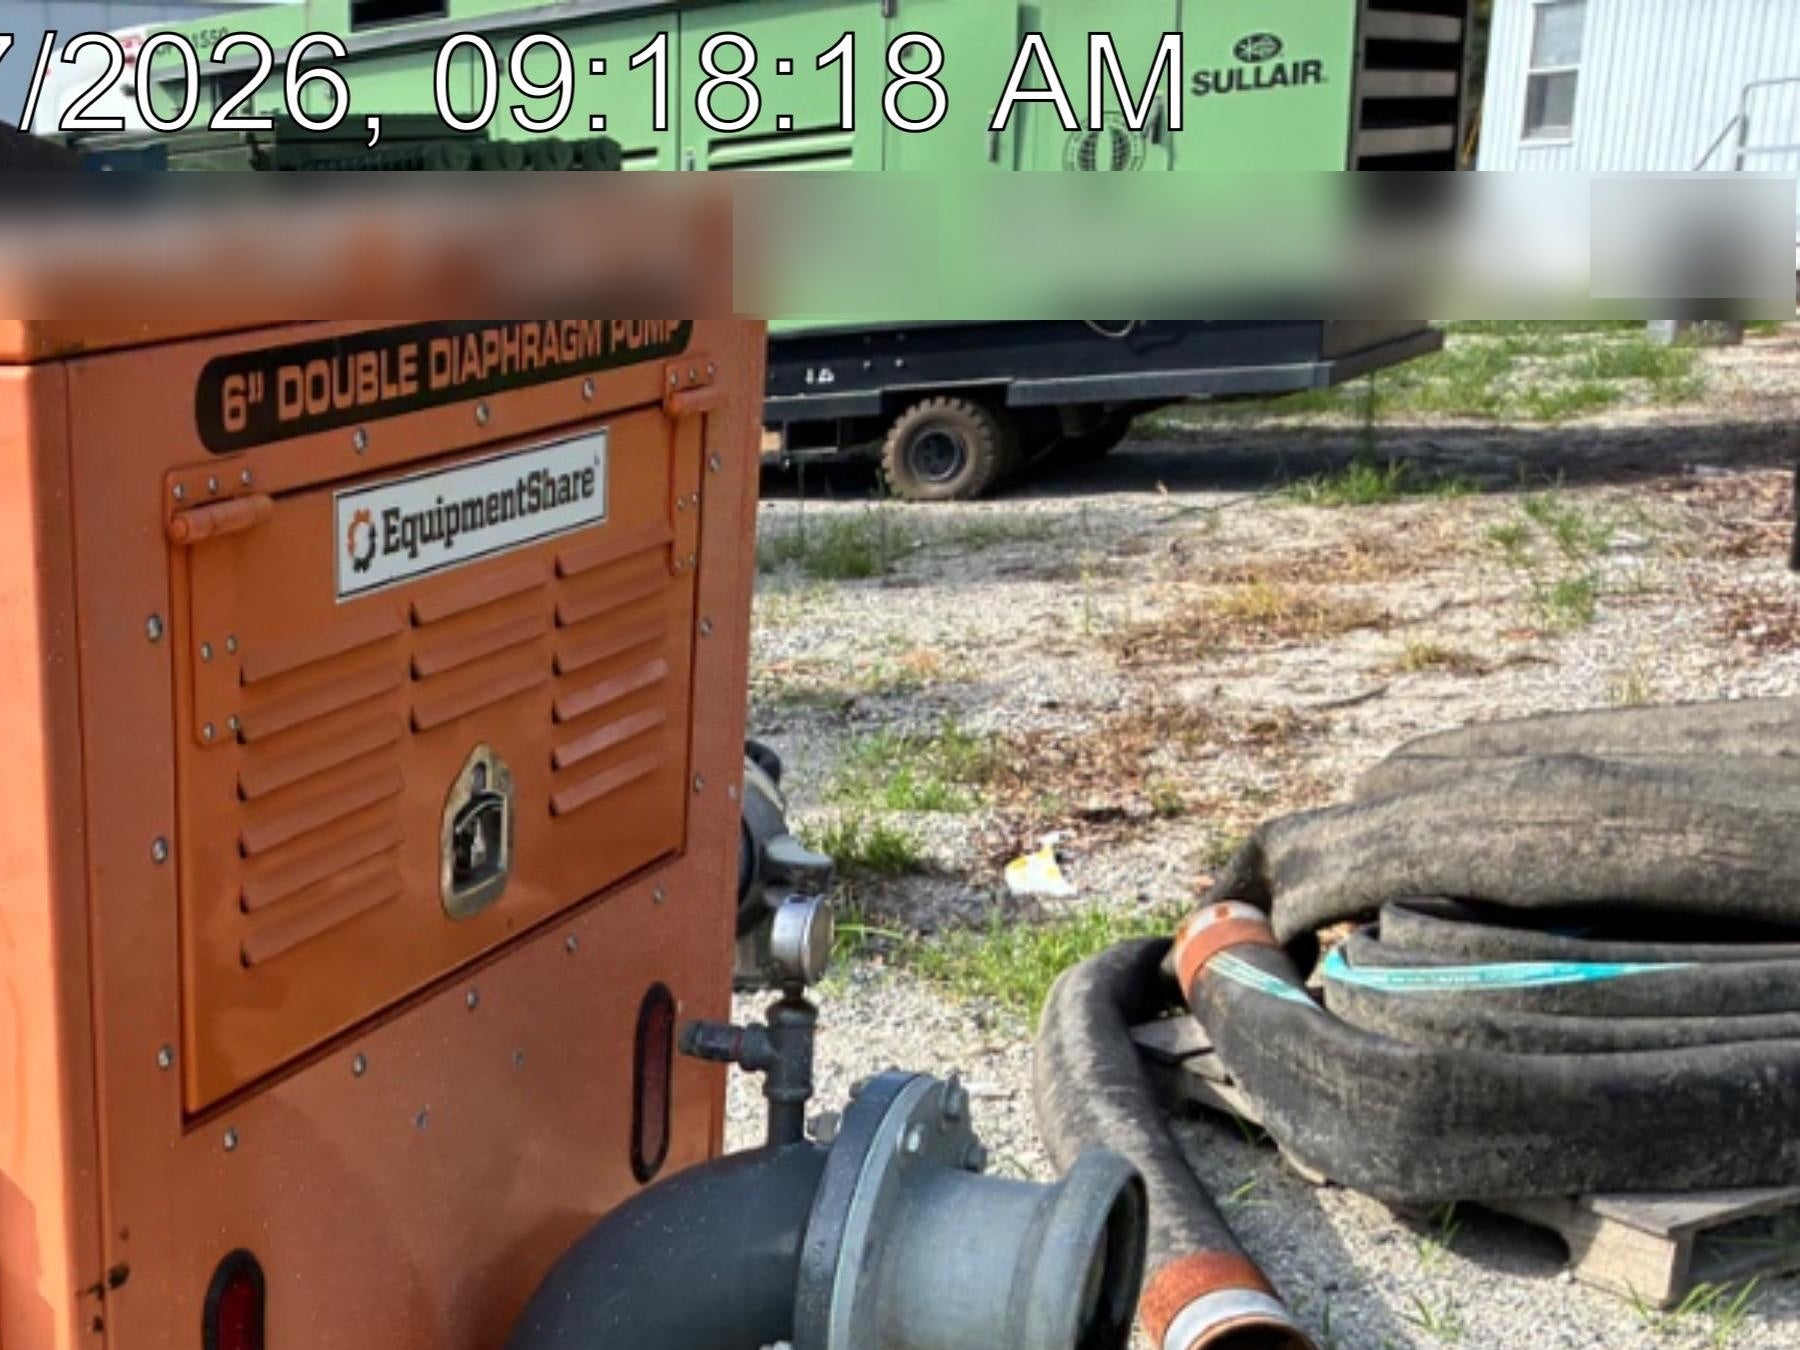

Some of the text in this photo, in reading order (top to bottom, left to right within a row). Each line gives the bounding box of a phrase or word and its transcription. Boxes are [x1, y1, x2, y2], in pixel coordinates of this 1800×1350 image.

[1191, 59, 1323, 97] SULLAIR
[221, 319, 681, 433] 6" DOUBLE DIAPHRAGM PUMP
[381, 464, 597, 560] EquipmentShare
